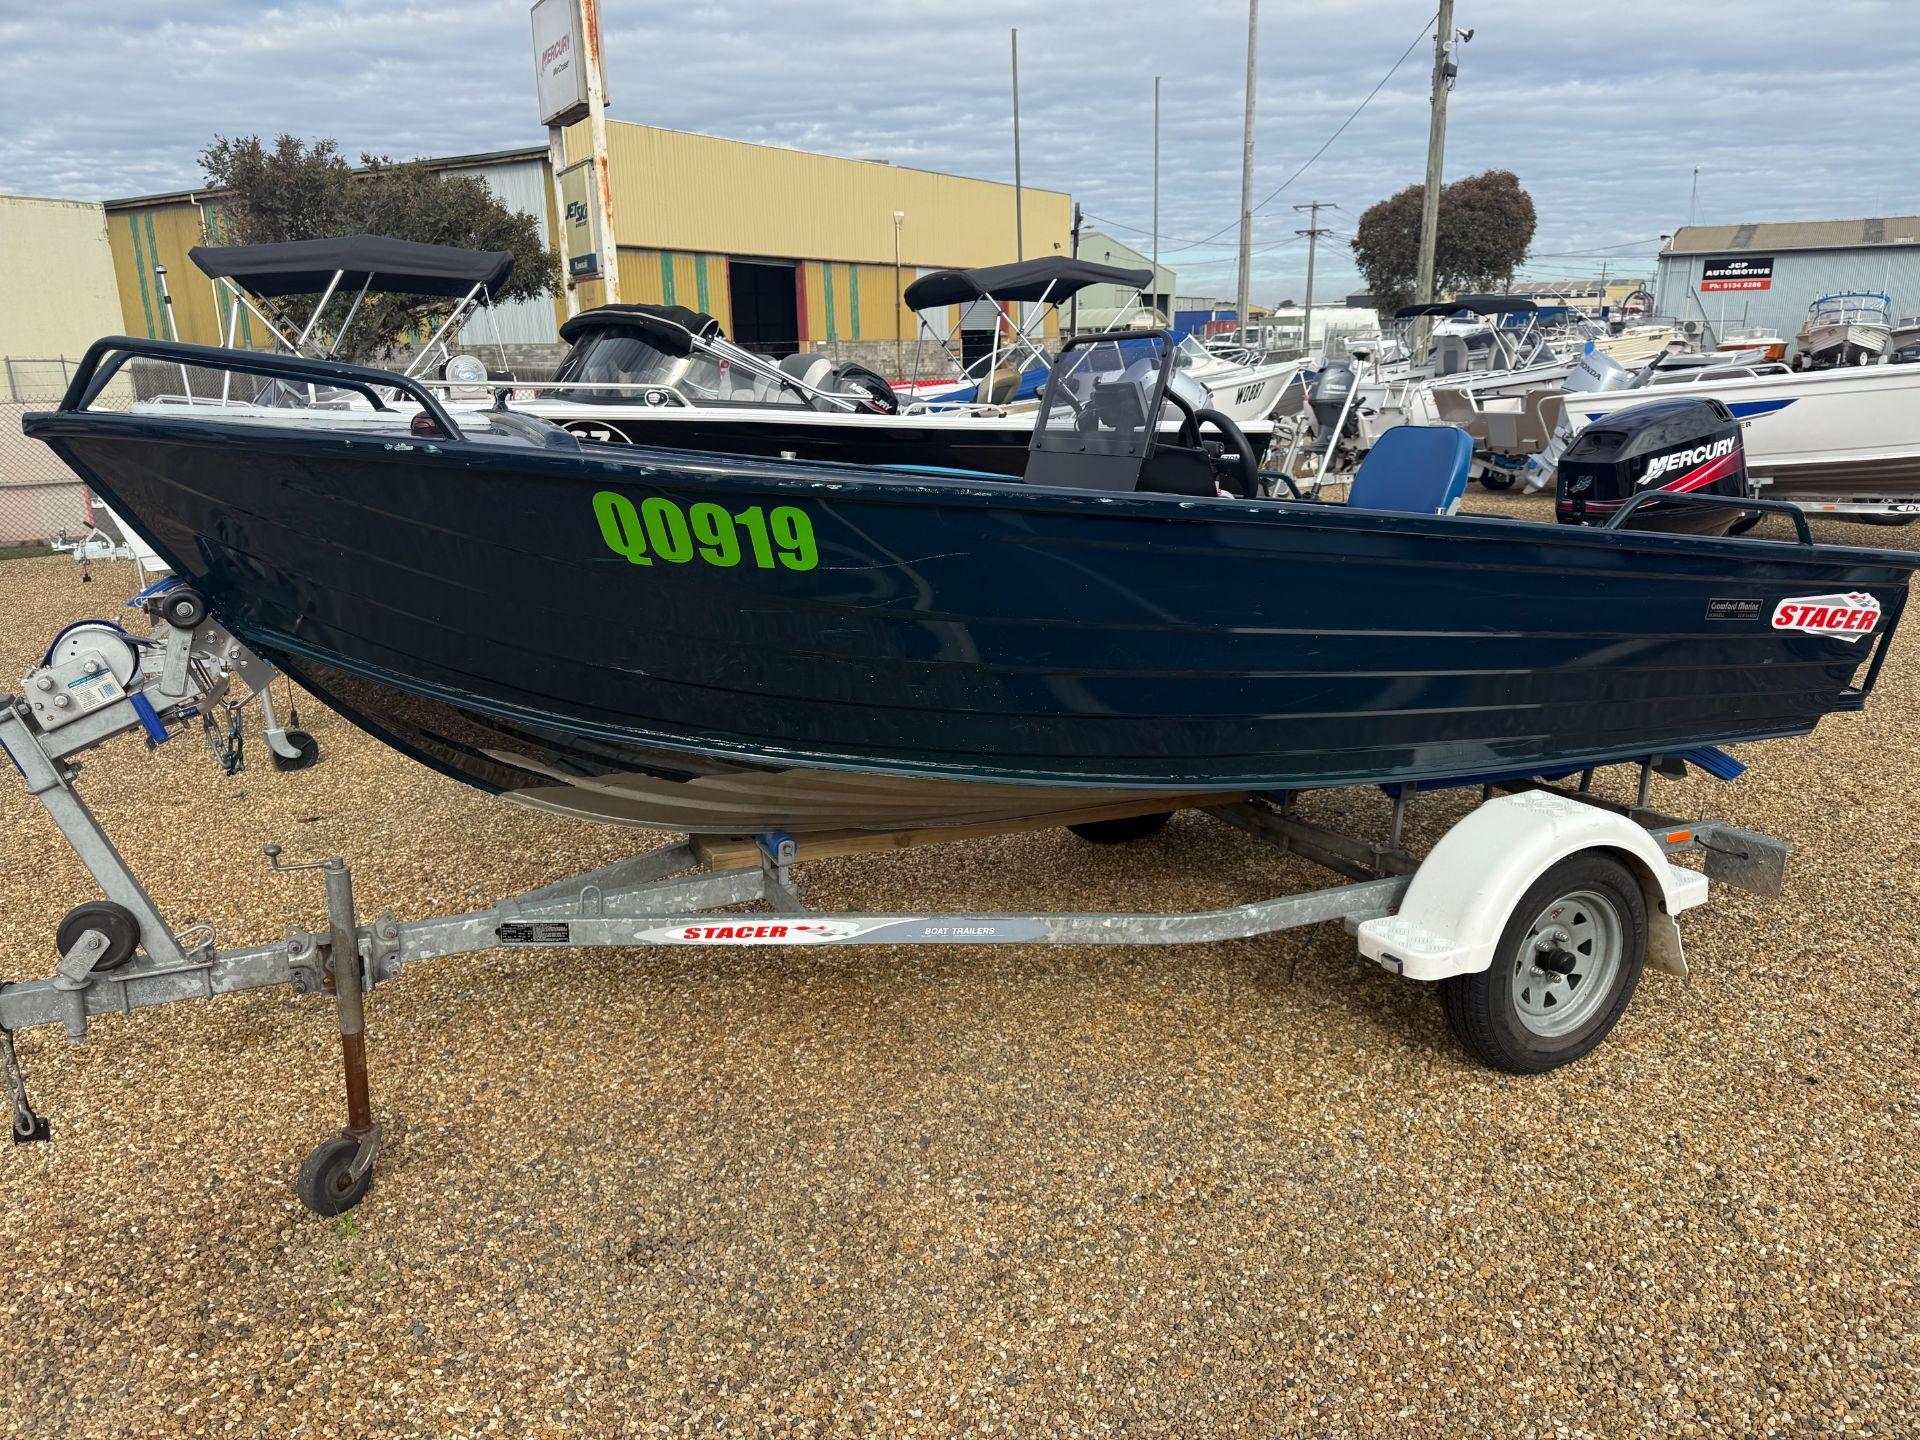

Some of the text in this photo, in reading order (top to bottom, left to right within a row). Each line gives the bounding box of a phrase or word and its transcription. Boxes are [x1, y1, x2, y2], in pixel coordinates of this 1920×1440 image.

[541, 33, 570, 74] MERCURY
[565, 201, 579, 220] JET
[1705, 268, 1771, 276] AUTOMOTIVE
[1637, 436, 1736, 485] MERCURY
[1775, 605, 1878, 630] STACER
[683, 926, 789, 940] STACER
[925, 927, 995, 935] BOAT TRAILERS
